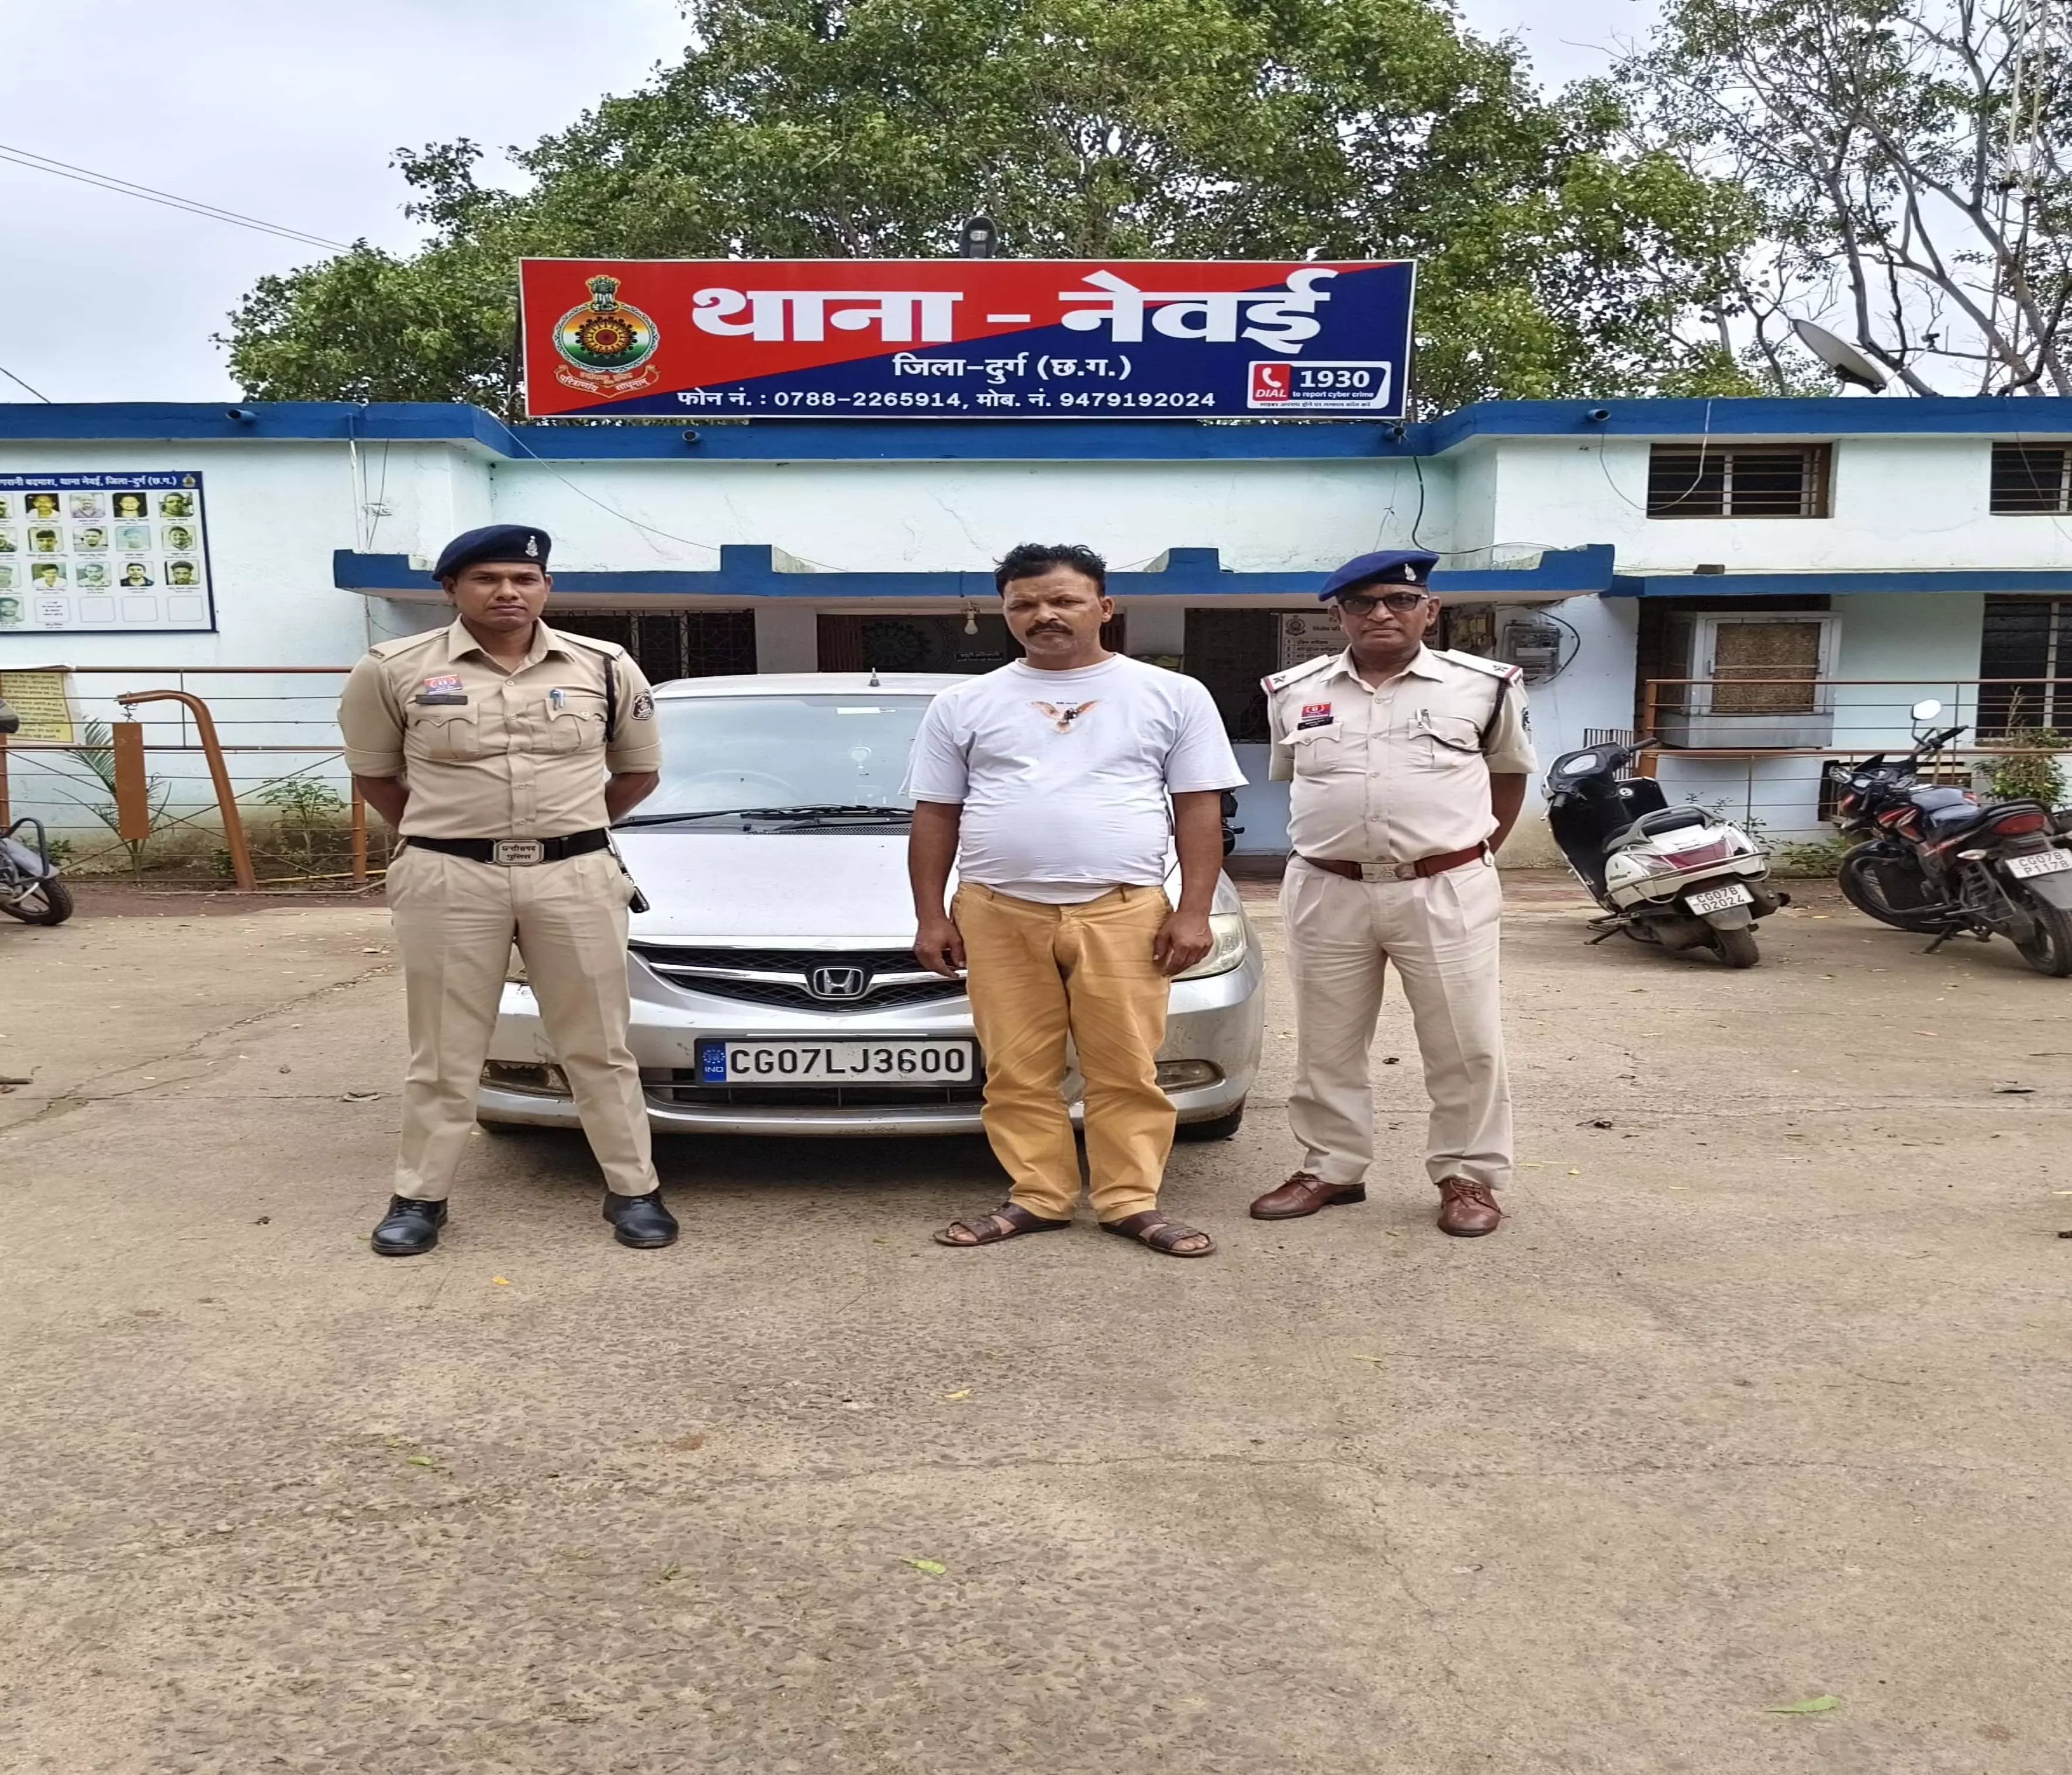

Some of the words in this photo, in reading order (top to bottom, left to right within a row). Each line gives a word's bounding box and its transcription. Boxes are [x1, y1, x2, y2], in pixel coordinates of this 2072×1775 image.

[692, 288, 964, 342] थाना
[1058, 268, 1339, 354] नेवई
[892, 351, 1029, 384] जिला-दुर्ग
[1037, 355, 1132, 380] (छ.ग.)
[1300, 370, 1370, 388] 1930
[677, 388, 723, 406] फोन
[728, 388, 752, 406] नं.
[775, 392, 968, 409] 0788-2265914,
[976, 389, 1021, 407] मोब.
[1027, 388, 1051, 407] नं.
[1060, 392, 1215, 407] 9479192024
[1255, 389, 1287, 398] DIAL
[2019, 852, 2063, 867] CG07B
[2024, 860, 2069, 875] P1178
[1697, 887, 1738, 903] CG07B
[730, 1048, 965, 1074] CG07LJ3600
